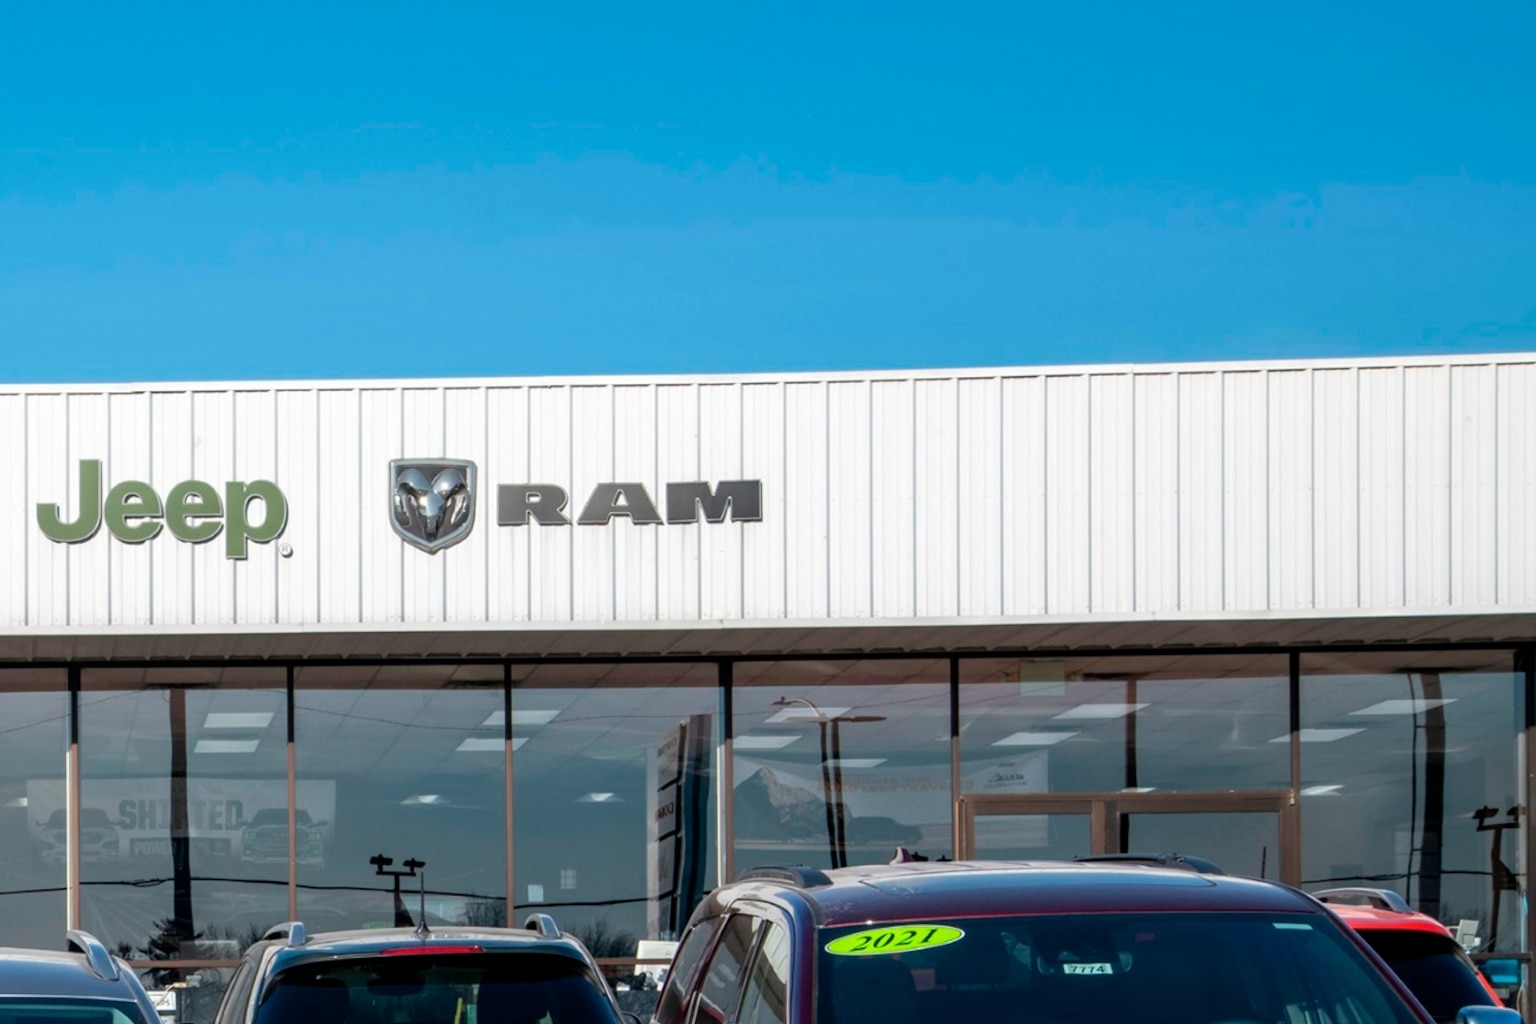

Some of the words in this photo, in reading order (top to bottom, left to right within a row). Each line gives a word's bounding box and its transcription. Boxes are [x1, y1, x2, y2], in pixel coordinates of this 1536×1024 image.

[36, 459, 288, 560] Jeep
[497, 479, 762, 526] RAM
[850, 928, 938, 953] 2021
